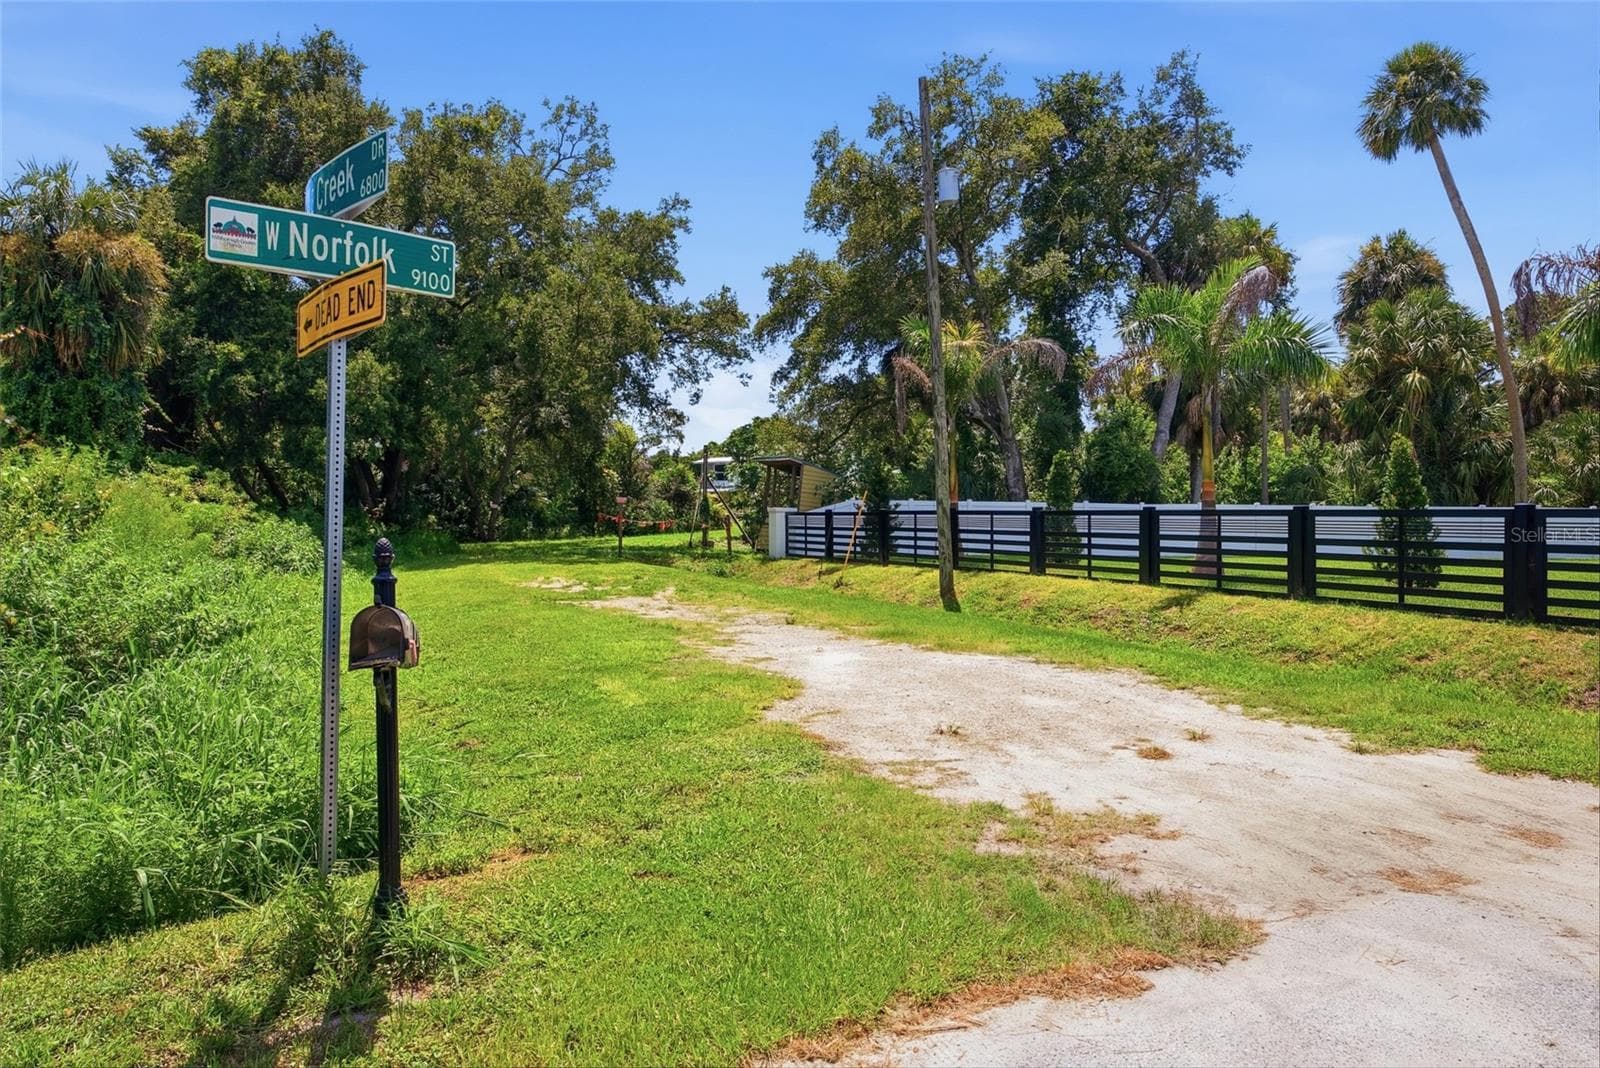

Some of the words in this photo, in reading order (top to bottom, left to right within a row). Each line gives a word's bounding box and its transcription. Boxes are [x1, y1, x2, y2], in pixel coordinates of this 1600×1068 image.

[316, 158, 355, 210] Creek
[371, 137, 385, 161] DR
[360, 169, 385, 197] 6800
[265, 220, 280, 251] W
[289, 221, 396, 274] Norfolk
[430, 245, 450, 263] ST
[315, 293, 340, 331] DEAD
[348, 280, 376, 315] END
[411, 269, 450, 292] 9100
